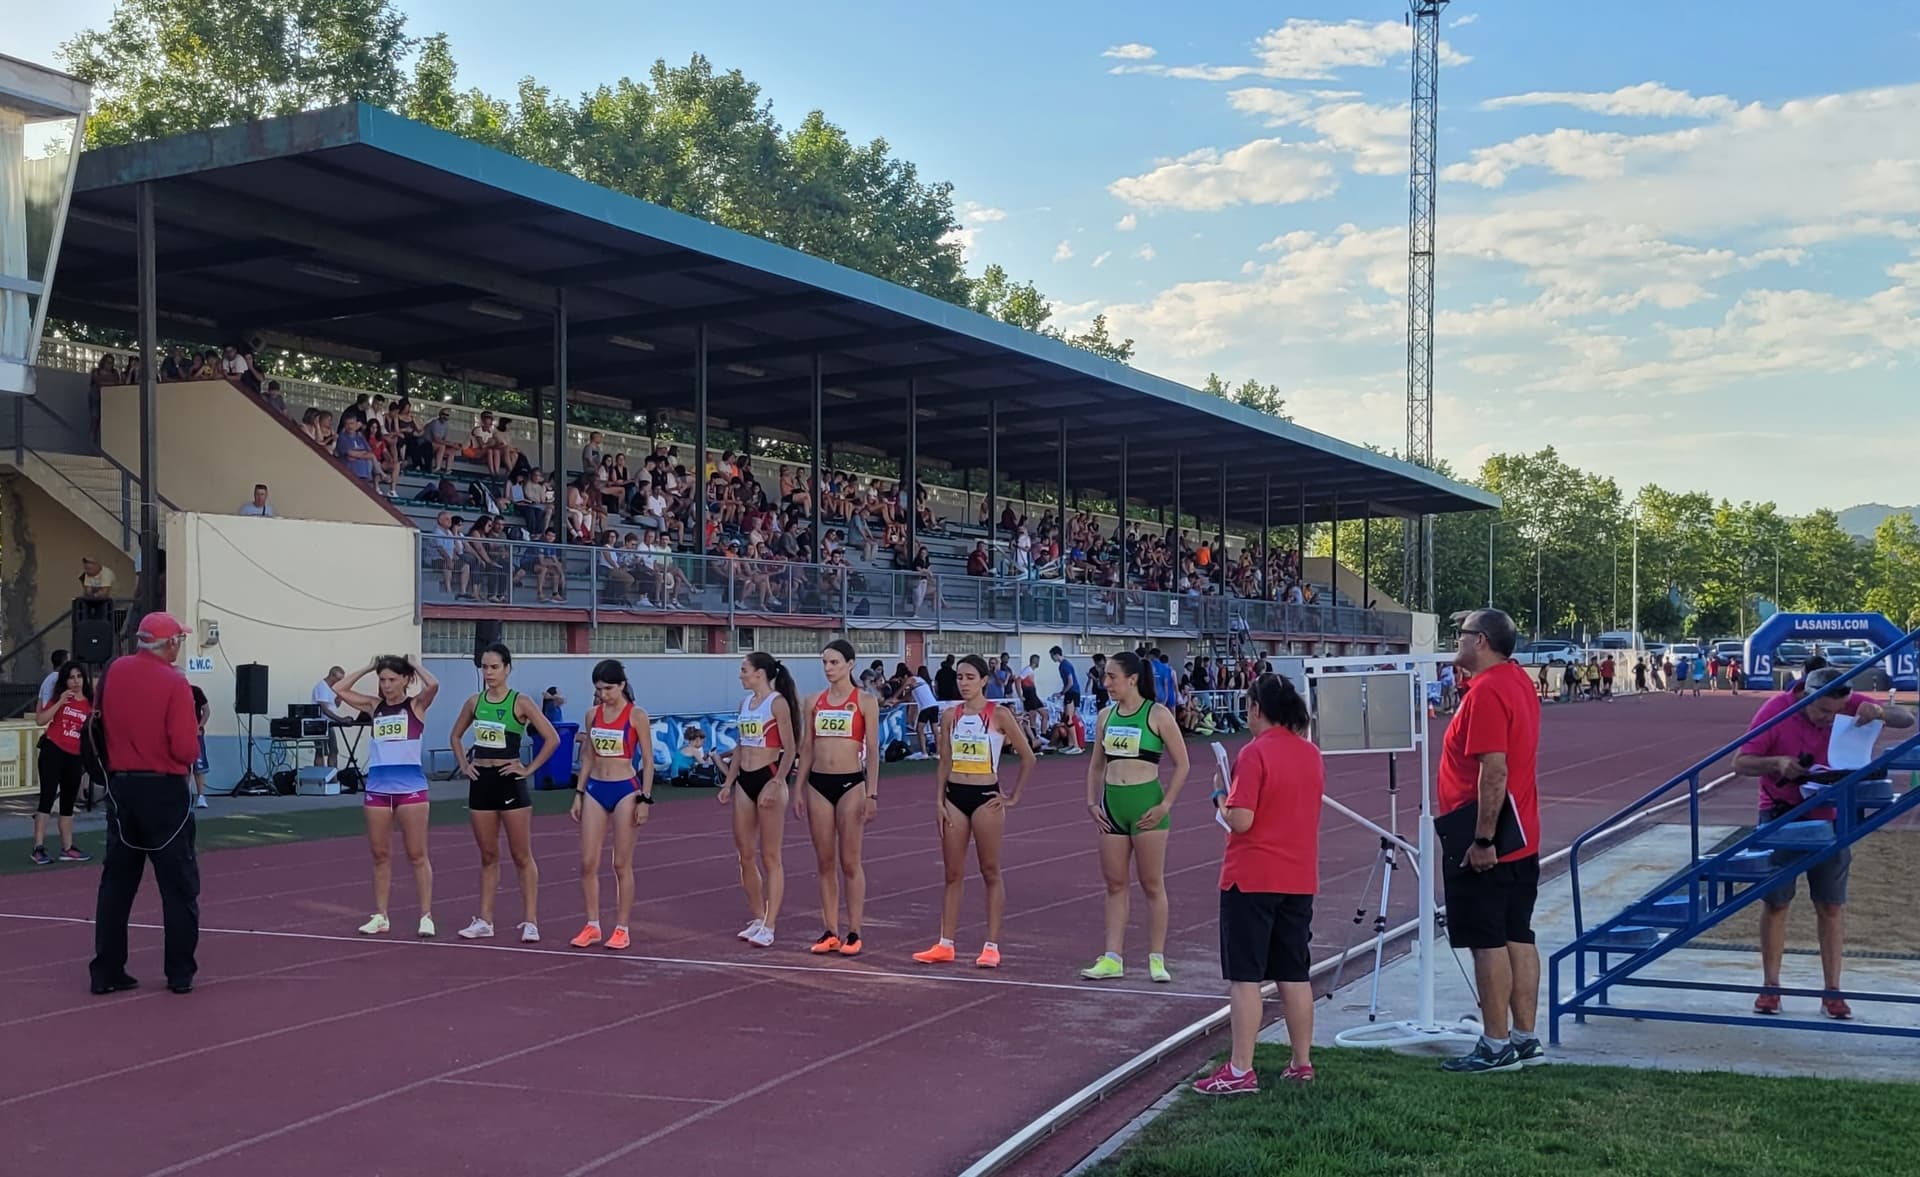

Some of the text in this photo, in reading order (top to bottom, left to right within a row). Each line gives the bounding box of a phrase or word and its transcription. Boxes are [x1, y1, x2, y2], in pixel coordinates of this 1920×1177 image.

[1795, 619, 1869, 630] LASANSI.COM
[1754, 654, 1771, 675] LS
[1897, 654, 1914, 674] LS
[379, 723, 402, 736] 339
[821, 718, 845, 731] 262
[481, 730, 497, 742] 46
[595, 738, 617, 750] 227
[962, 742, 976, 755] 21
[1112, 736, 1128, 750] 44
